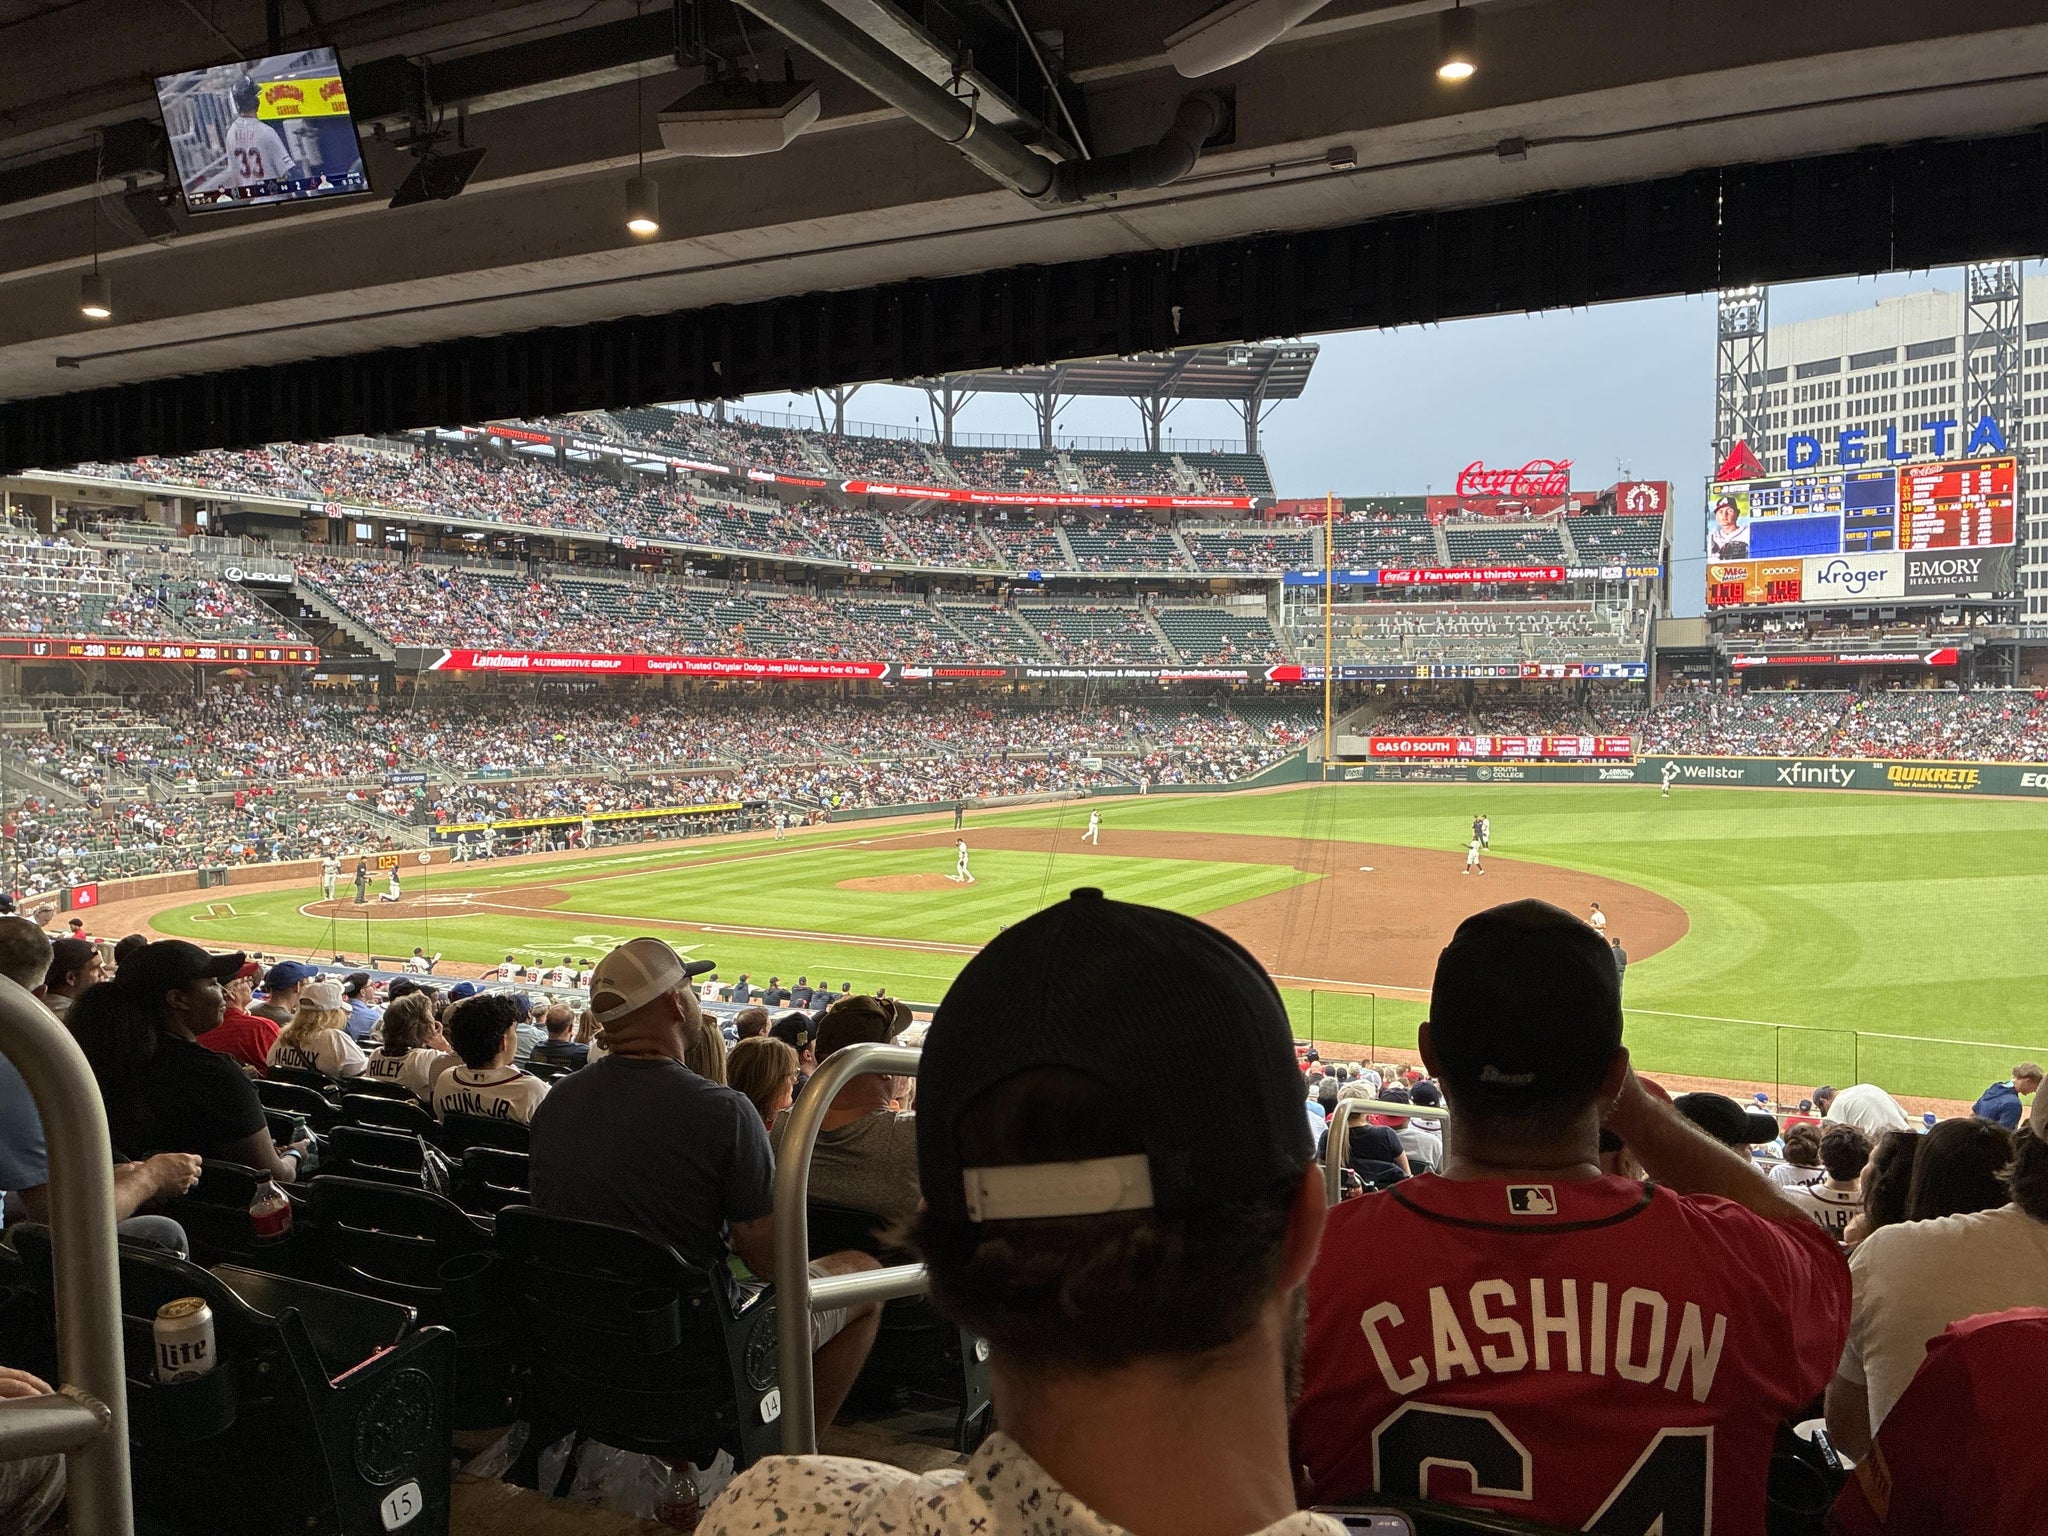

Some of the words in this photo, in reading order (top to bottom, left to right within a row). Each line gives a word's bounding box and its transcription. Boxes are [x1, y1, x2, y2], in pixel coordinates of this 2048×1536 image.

[234, 148, 265, 178] 33
[487, 426, 529, 441] AUTOMOTIVE
[529, 432, 551, 443] GROUP
[1787, 415, 2008, 470] DELTA
[1456, 458, 1576, 498] Coca-Cola
[866, 484, 897, 494] Landmark
[899, 488, 932, 496] AUTOMOTIVE
[933, 490, 951, 498] GROUP
[1015, 495, 1038, 503] Chrysler
[1058, 496, 1070, 505] Jeep
[325, 502, 342, 518] 41
[1902, 503, 1912, 512] 31
[622, 535, 637, 549] 44
[1424, 572, 1442, 580] Fan
[1444, 571, 1470, 580] work
[1472, 571, 1482, 579] is
[1483, 570, 1522, 580] thirsty
[1523, 570, 1547, 579] work
[1585, 567, 1599, 578] PM
[1724, 567, 1747, 576] MEGA
[1909, 559, 1983, 577] EMORY
[244, 571, 292, 583] LEXUS
[1817, 560, 1888, 594] Kroger
[1910, 575, 1979, 585] HEALTHCARE
[1380, 615, 1426, 634] HANK
[1437, 615, 1497, 633] AARON
[1504, 614, 1592, 632] TERRACE
[34, 643, 46, 655] LF
[70, 646, 83, 654] AVG
[109, 647, 121, 655] SLG
[148, 647, 160, 656] OPS
[472, 653, 530, 667] Landmark
[532, 657, 590, 667] AUTOMOTIVE
[591, 660, 622, 668] GROUP
[647, 659, 683, 672] Georgia's
[684, 661, 712, 671] Trusted
[713, 661, 742, 673] Chrysler
[744, 662, 765, 673] Dodge
[766, 663, 782, 674] Jeep
[783, 663, 799, 672] RAM
[799, 664, 819, 673] Dealer
[820, 665, 829, 673] for
[830, 665, 843, 674] Over
[844, 666, 853, 674] 40
[853, 666, 870, 674] Years
[1768, 656, 1808, 664] AUTOMOTIVE
[1808, 655, 1832, 663] GROUP
[1840, 654, 1919, 662] ShopLandmarkCars.com
[934, 669, 980, 677] AUTOMOTIVE
[980, 669, 1006, 677] GROUP
[1027, 669, 1041, 677] Find
[1052, 669, 1058, 677] in
[1059, 669, 1088, 678] Atlanta,
[1088, 669, 1116, 677] Morrow
[1117, 669, 1123, 677] &
[1124, 669, 1150, 677] Athens
[1376, 742, 1400, 752] GAS
[1412, 742, 1450, 752] SOUTH
[1457, 741, 1473, 752] AL
[1683, 764, 1745, 779] Wellstar
[1776, 762, 1856, 787] xfinity
[1888, 765, 1981, 785] QUIKRETE
[2021, 773, 2048, 789] EQ
[1912, 782, 1943, 790] America's
[370, 1058, 403, 1079] RILEY
[1360, 1277, 1727, 1403] CASHION
[764, 1395, 779, 1418] 14
[390, 1491, 413, 1522] 15
